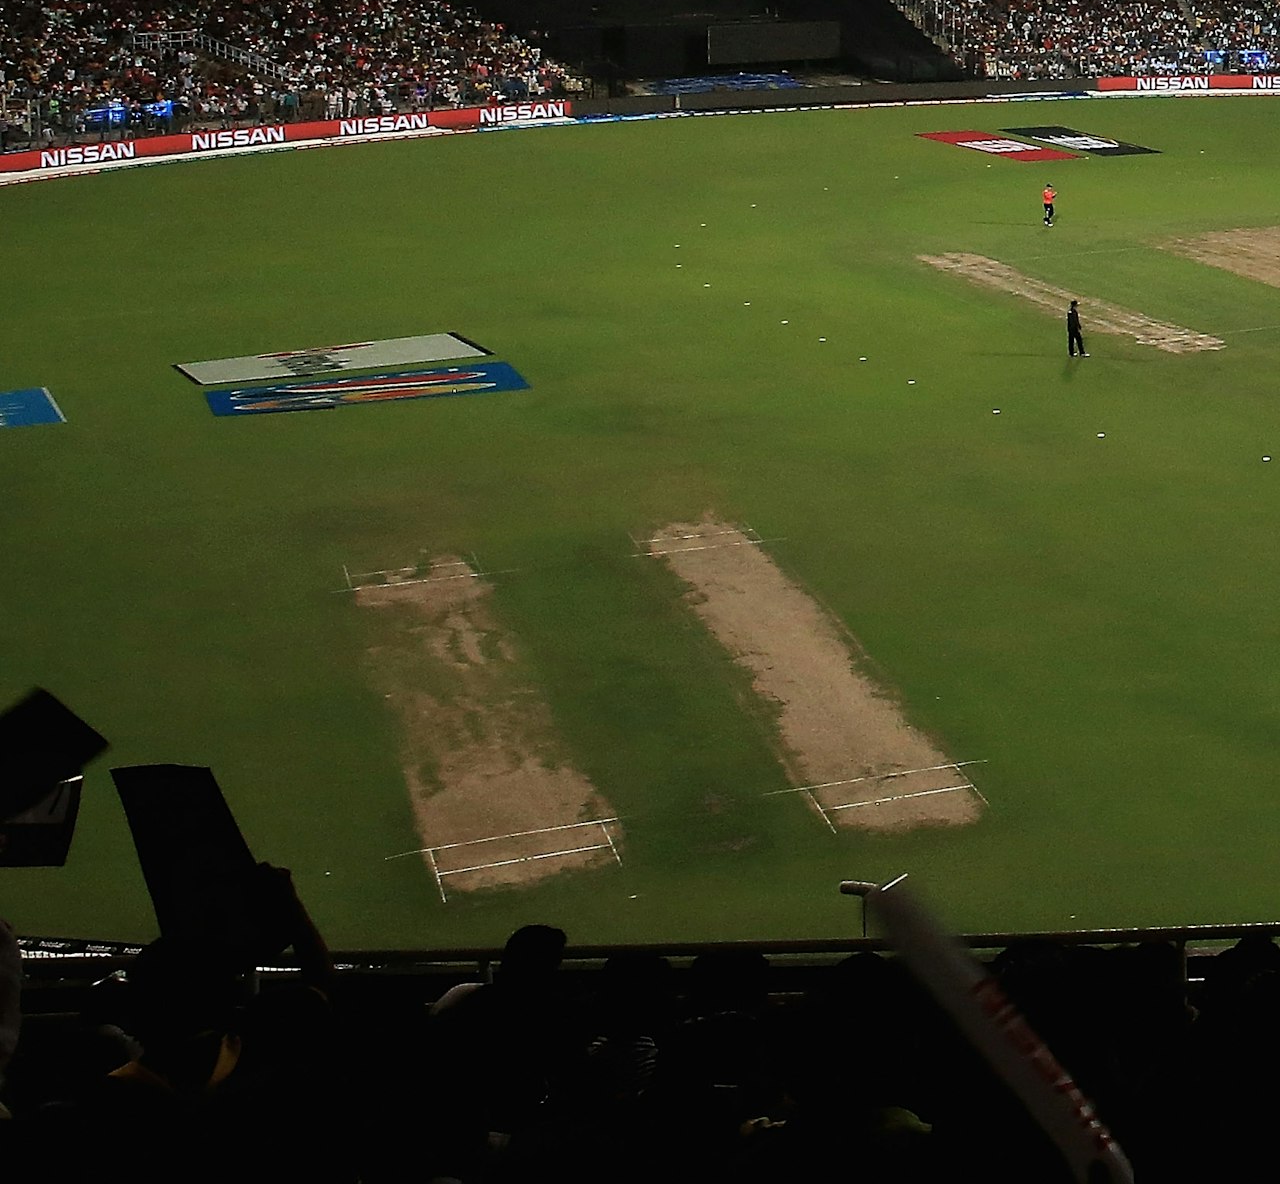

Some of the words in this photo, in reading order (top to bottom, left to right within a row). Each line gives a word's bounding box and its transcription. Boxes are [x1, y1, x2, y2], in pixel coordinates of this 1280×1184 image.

[1137, 76, 1209, 90] NISSAN
[480, 103, 564, 123] NISSAN
[339, 114, 428, 136] NISSAN
[191, 126, 285, 151] NISSAN
[40, 141, 136, 169] NISSAN
